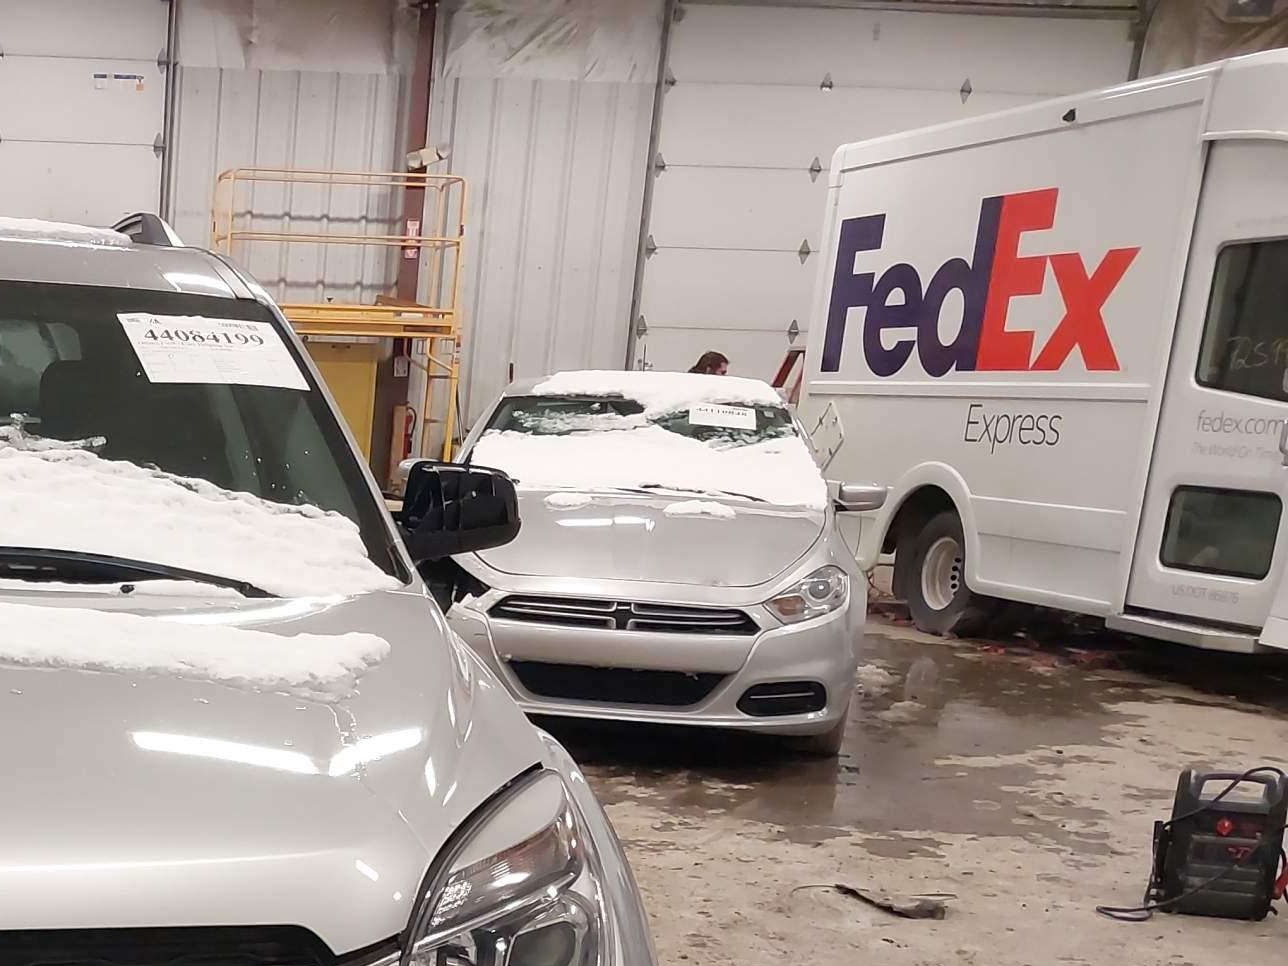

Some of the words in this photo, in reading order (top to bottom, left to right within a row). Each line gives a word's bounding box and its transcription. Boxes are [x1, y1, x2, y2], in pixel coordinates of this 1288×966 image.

[820, 187, 1141, 378] FedEx
[144, 328, 265, 346] 44084199
[964, 403, 1062, 454] Express
[1196, 409, 1284, 435] fedex.com
